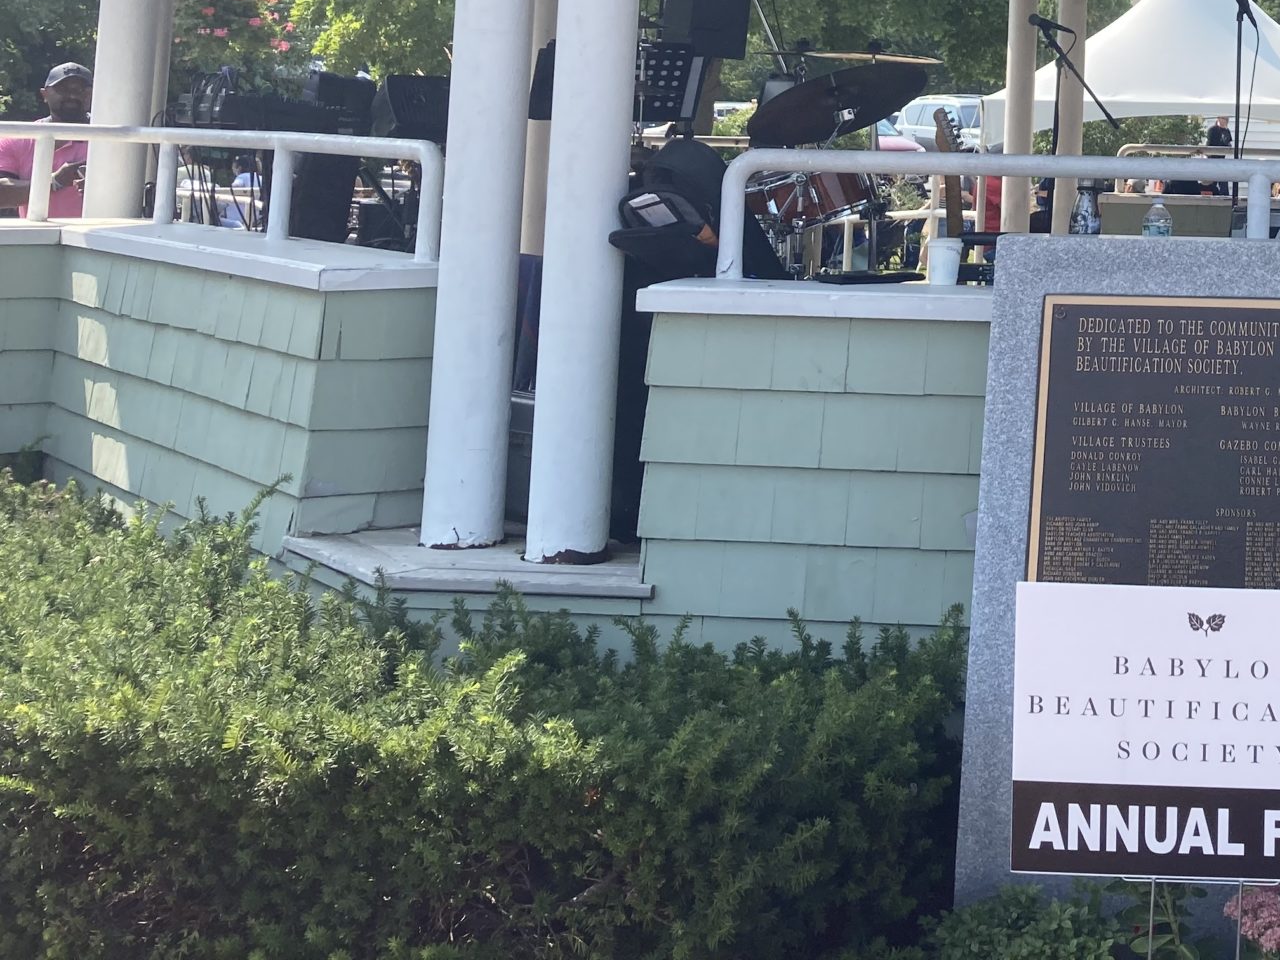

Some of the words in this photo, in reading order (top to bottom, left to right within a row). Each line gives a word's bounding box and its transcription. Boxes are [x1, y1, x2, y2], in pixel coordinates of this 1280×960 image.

[1079, 317, 1151, 334] DEDICATED
[1157, 319, 1174, 334] TO
[1180, 320, 1204, 335] THE
[1077, 337, 1093, 352] BY
[1101, 337, 1125, 353] THE
[1133, 338, 1187, 355] VILLAGE
[1194, 339, 1210, 355] OF
[1216, 339, 1275, 357] BABYLON
[1076, 356, 1182, 374] BEAUTIFICATION
[1187, 358, 1243, 376] SOCIETY.
[1174, 385, 1224, 395] ARCHITECT:
[1229, 386, 1261, 396] ROBERT
[1074, 402, 1116, 414] VILLAGE
[1121, 403, 1133, 414] OF
[1139, 403, 1184, 415] BABYLON
[1220, 405, 1265, 418] BABYLON
[1072, 417, 1107, 427] GILBERT
[1158, 419, 1188, 429] MAYOR
[1241, 421, 1270, 431] WAYNE
[1072, 436, 1115, 448] VILLAGE
[1121, 437, 1171, 449] TRUSTEES
[1219, 440, 1259, 451] GAZEBO
[1071, 451, 1104, 461] DONALD
[1109, 452, 1141, 462] CONROY
[1240, 455, 1268, 465] ISABEL
[1070, 462, 1097, 471] GAYLE
[1101, 463, 1140, 472] LABENOW
[1240, 467, 1262, 476] CARL
[1069, 472, 1091, 481] JOHN
[1096, 473, 1130, 482] RINKLIN
[1239, 477, 1270, 486] CONNIE
[1069, 482, 1091, 491] JOHN
[1095, 483, 1136, 493] VIDOVICH
[1239, 487, 1272, 496] ROBERT
[1215, 508, 1257, 518] SPONSORS
[1028, 802, 1245, 857] ANNUAL
